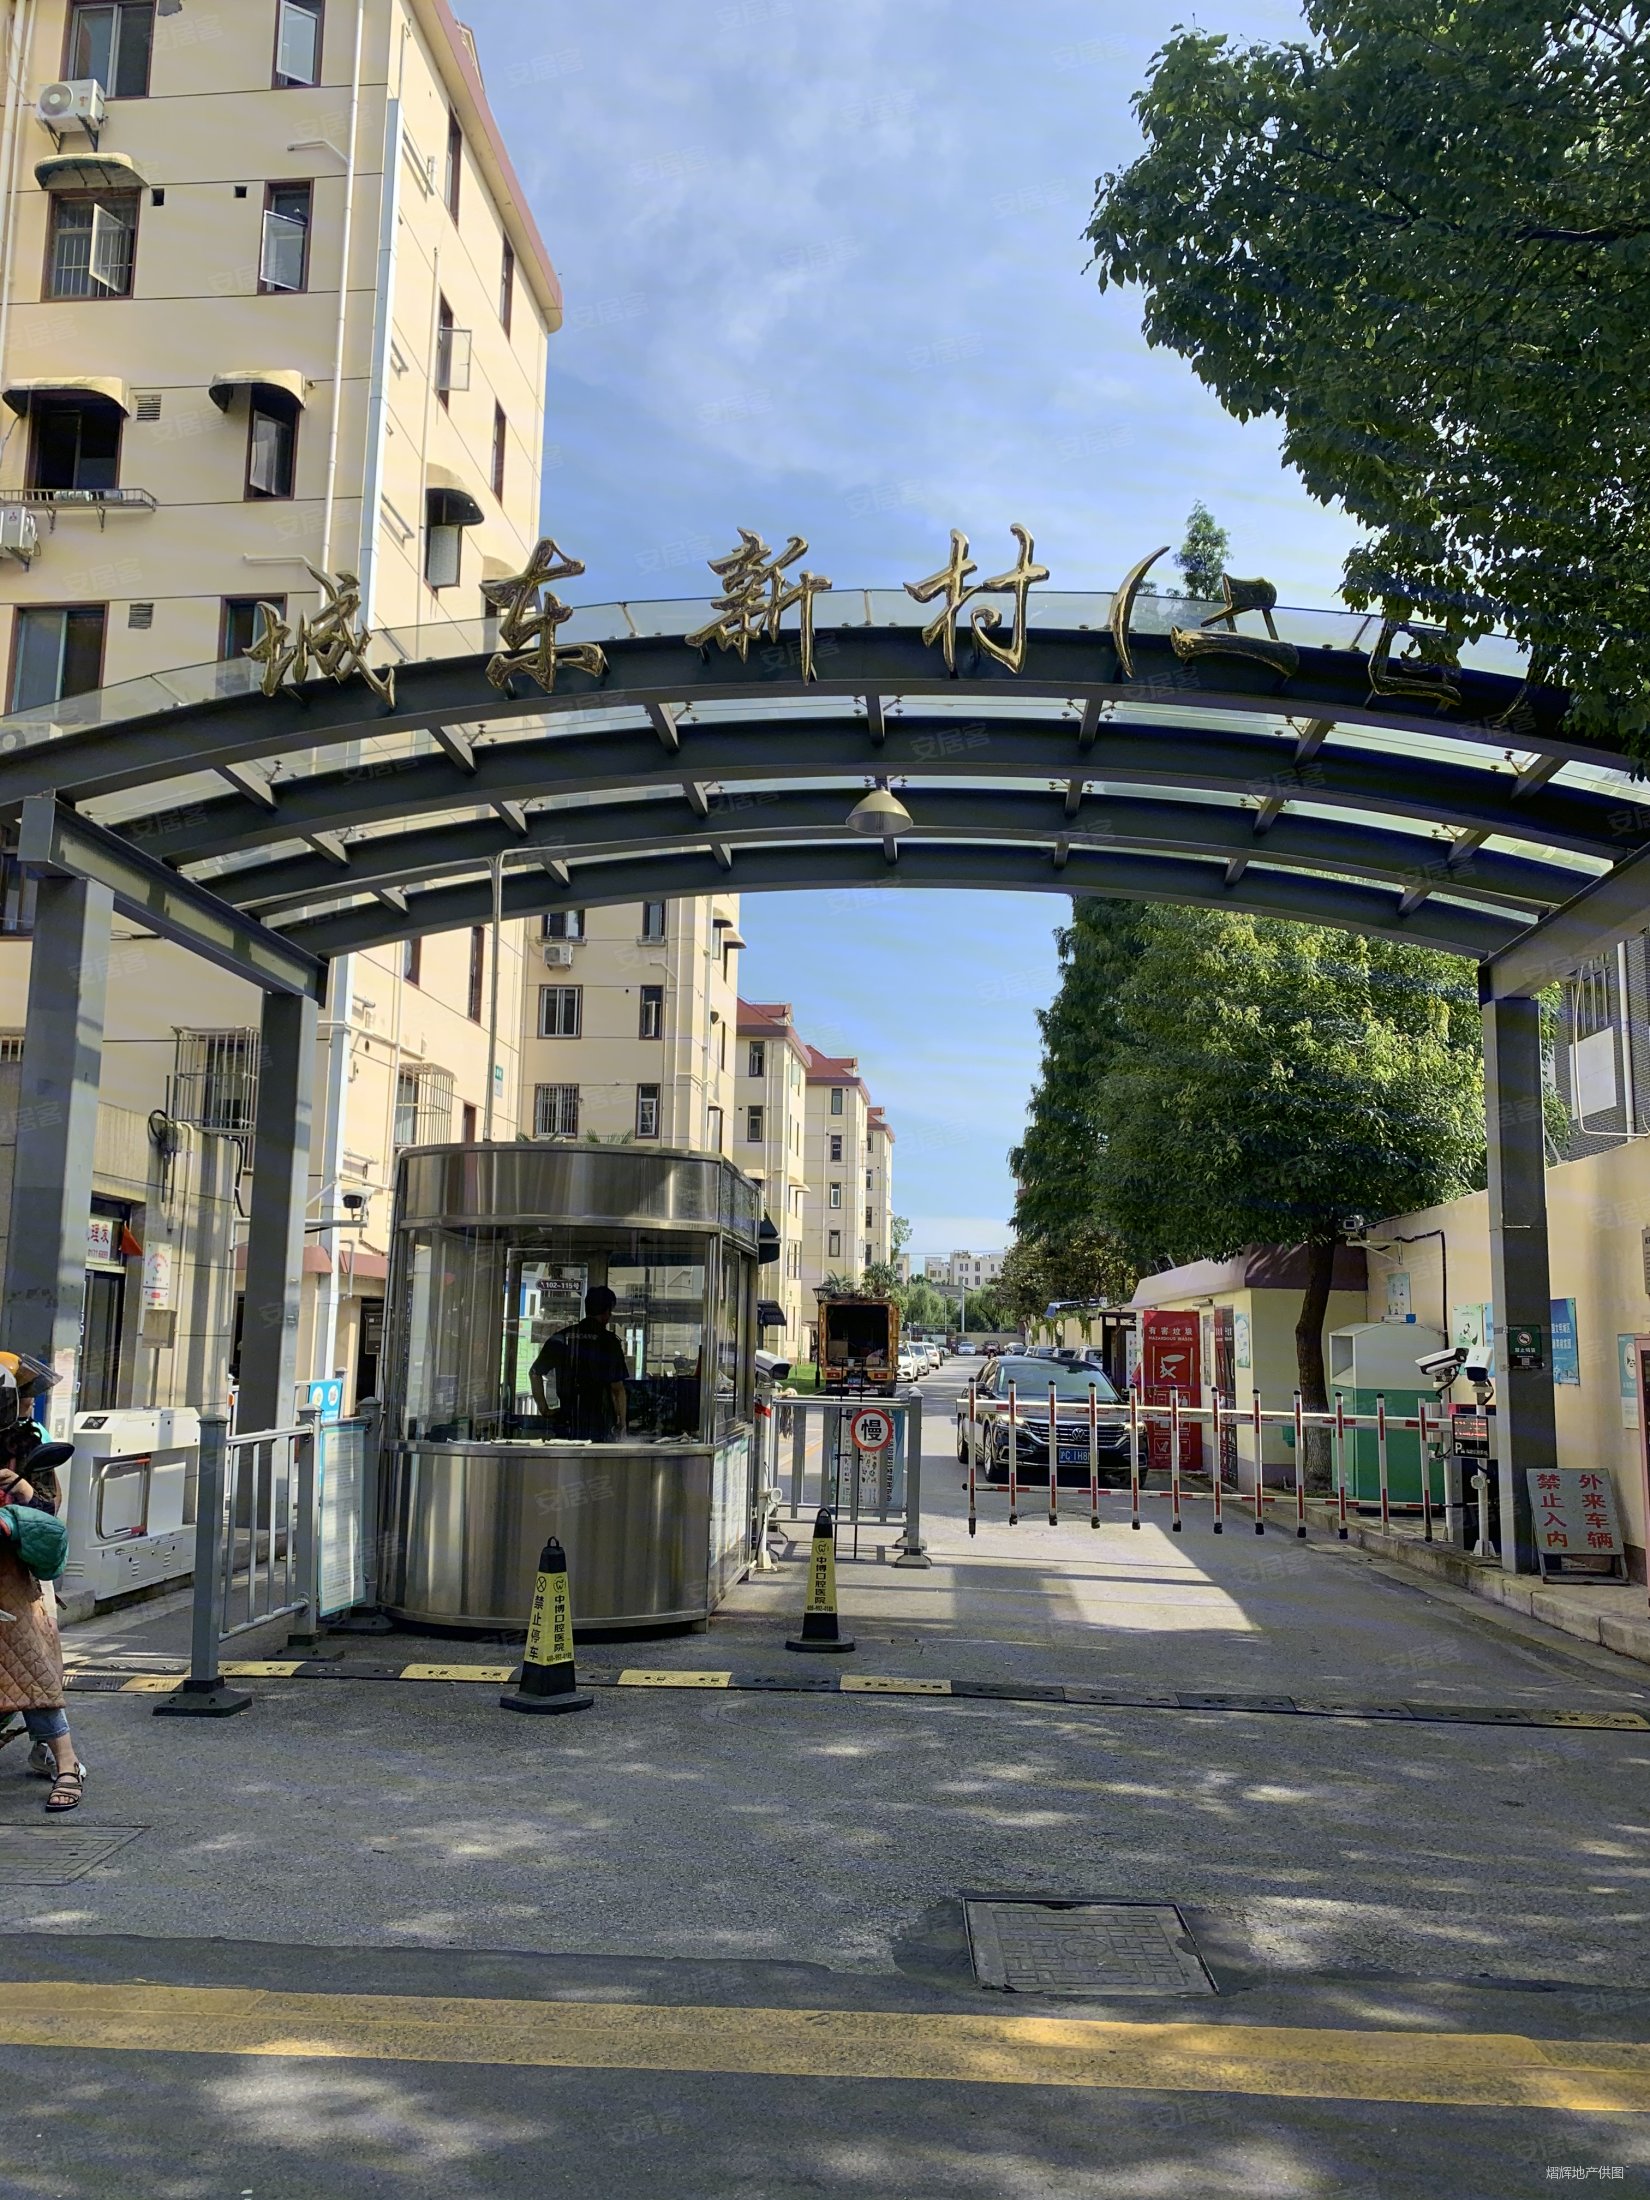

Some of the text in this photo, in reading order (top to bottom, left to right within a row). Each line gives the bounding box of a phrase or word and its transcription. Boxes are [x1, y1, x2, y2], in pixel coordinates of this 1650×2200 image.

[1148, 1326, 1193, 1336] 有害垃圾
[861, 1418, 882, 1442] 慢
[1536, 1472, 1569, 1548] 禁止入内
[1578, 1473, 1614, 1549] 外来车辆
[814, 1556, 827, 1605] 中博口腔医院
[529, 1595, 545, 1661] 禁止停车
[553, 1594, 566, 1653] 中博口腔医院
